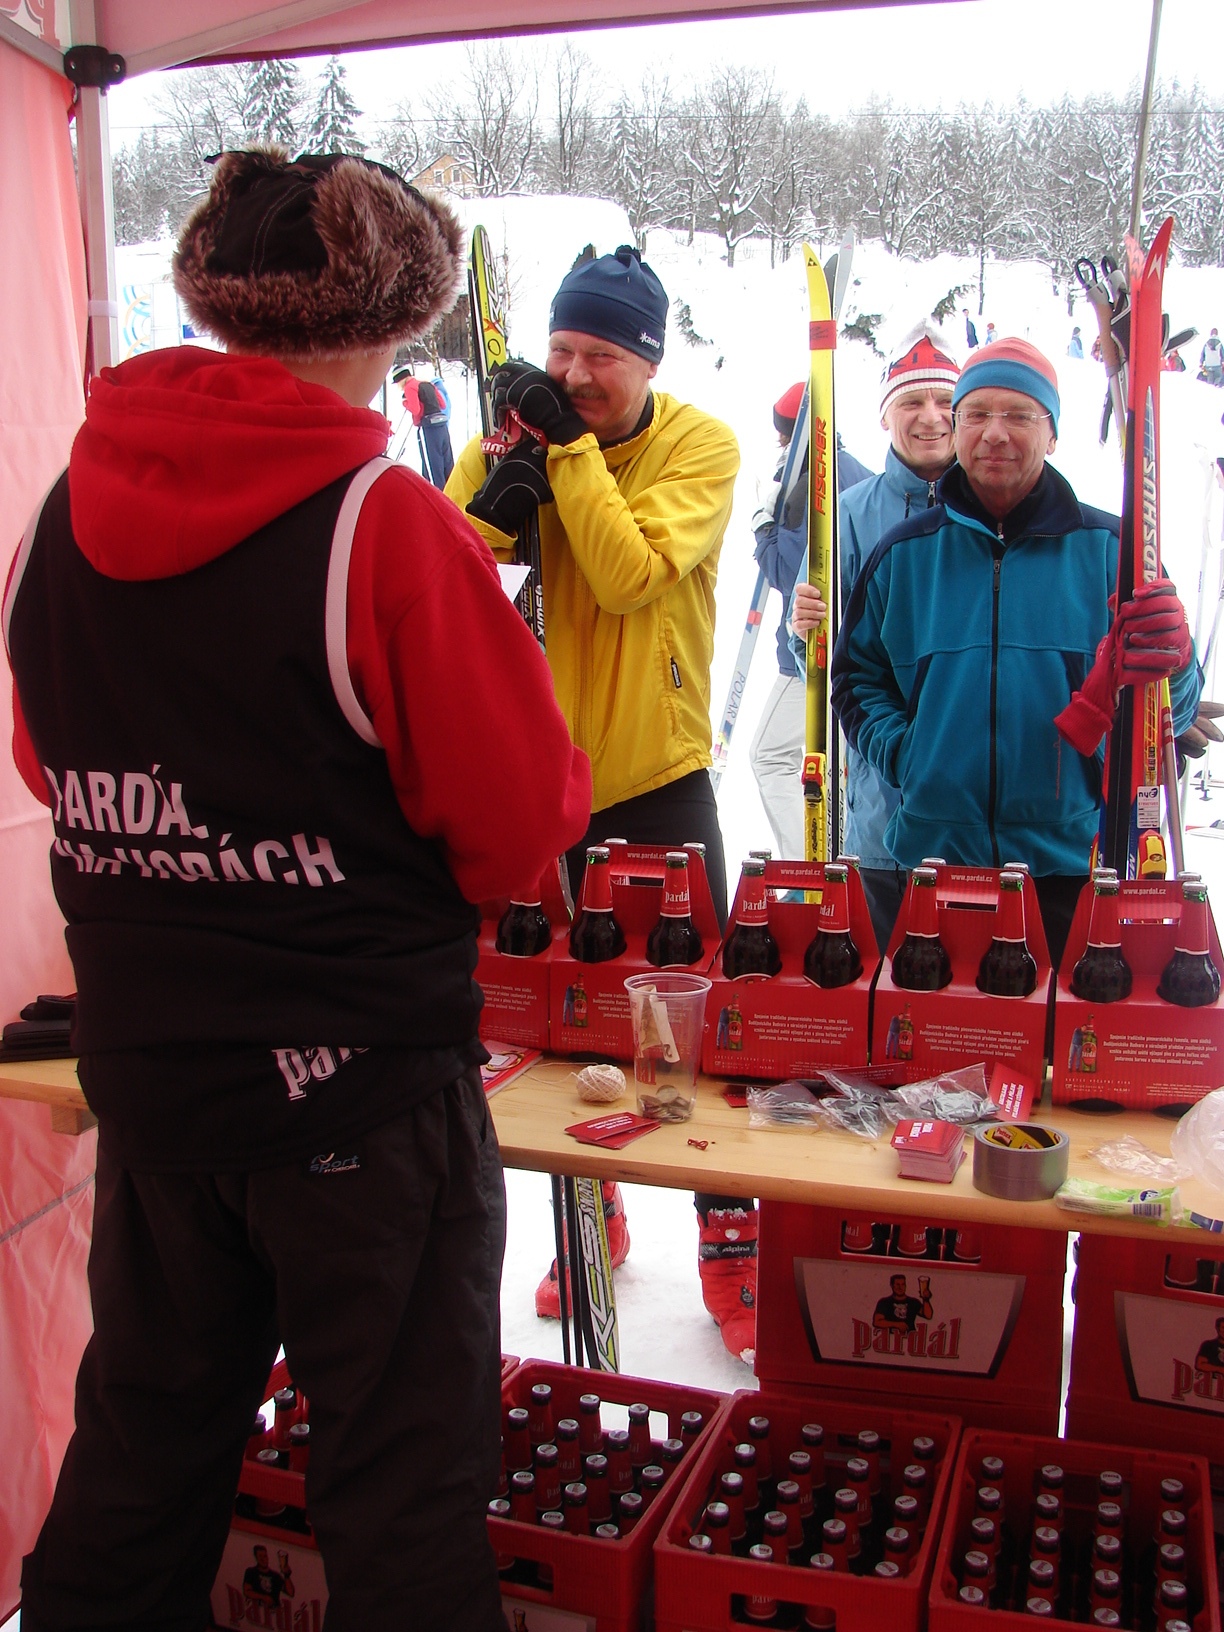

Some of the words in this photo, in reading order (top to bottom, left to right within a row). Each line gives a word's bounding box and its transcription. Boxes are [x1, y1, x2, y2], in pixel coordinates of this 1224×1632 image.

[640, 332, 661, 349] kama
[814, 416, 827, 516] FISCHER
[1143, 457, 1157, 585] ADSHUS
[727, 671, 746, 719] POLAR
[780, 868, 821, 876] www.pardal.cz
[951, 874, 993, 883] www.pardal.cz
[1123, 888, 1166, 896] www.pardal.cz
[851, 1316, 962, 1359] pardál
